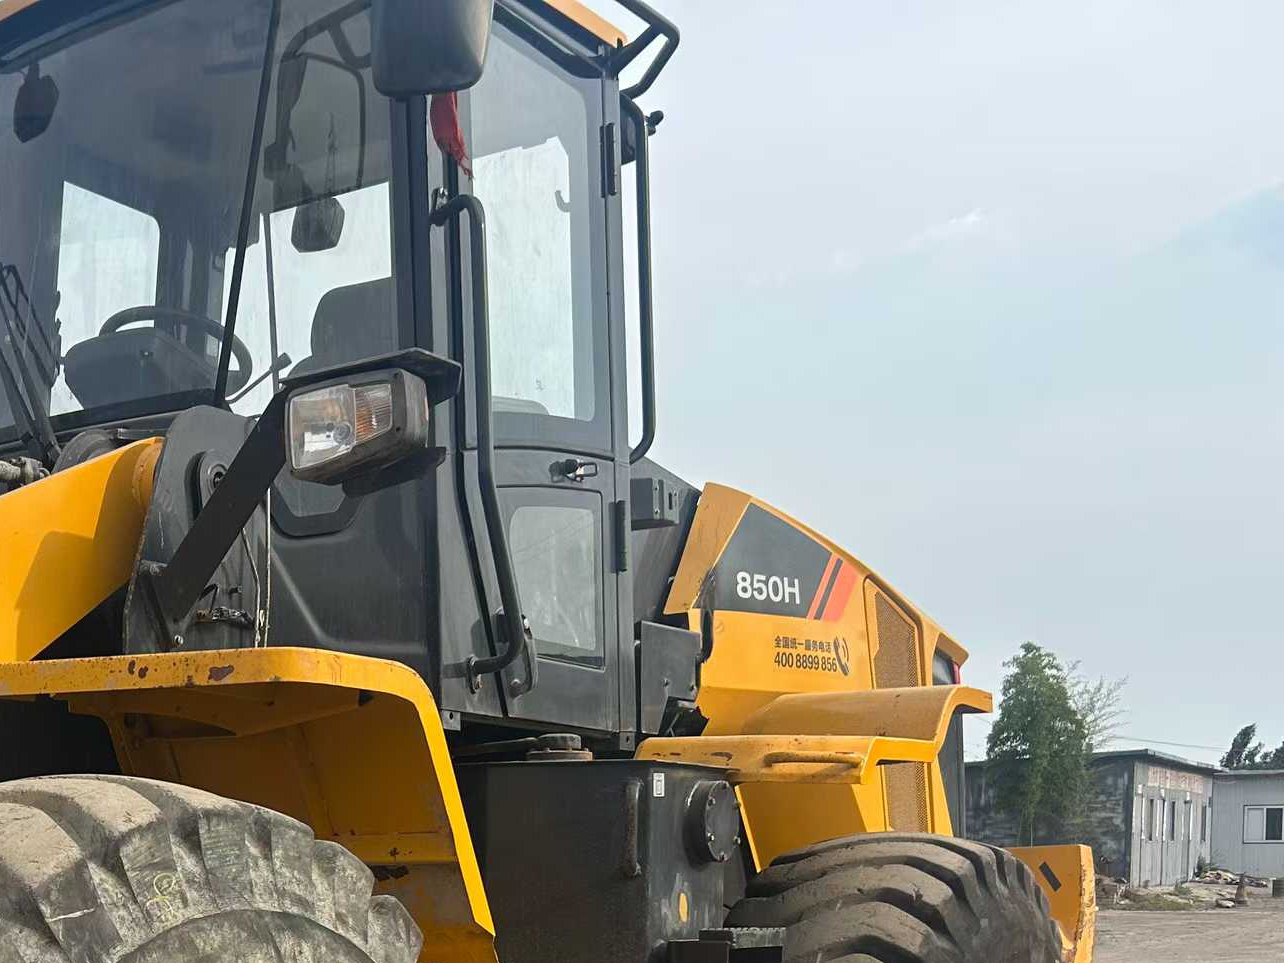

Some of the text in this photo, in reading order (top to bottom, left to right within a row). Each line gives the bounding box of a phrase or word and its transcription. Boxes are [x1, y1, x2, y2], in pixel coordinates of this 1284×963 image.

[736, 571, 800, 605] 850H
[774, 635, 832, 653] 全国统一服务电话
[774, 651, 837, 673] 400 8899 856
